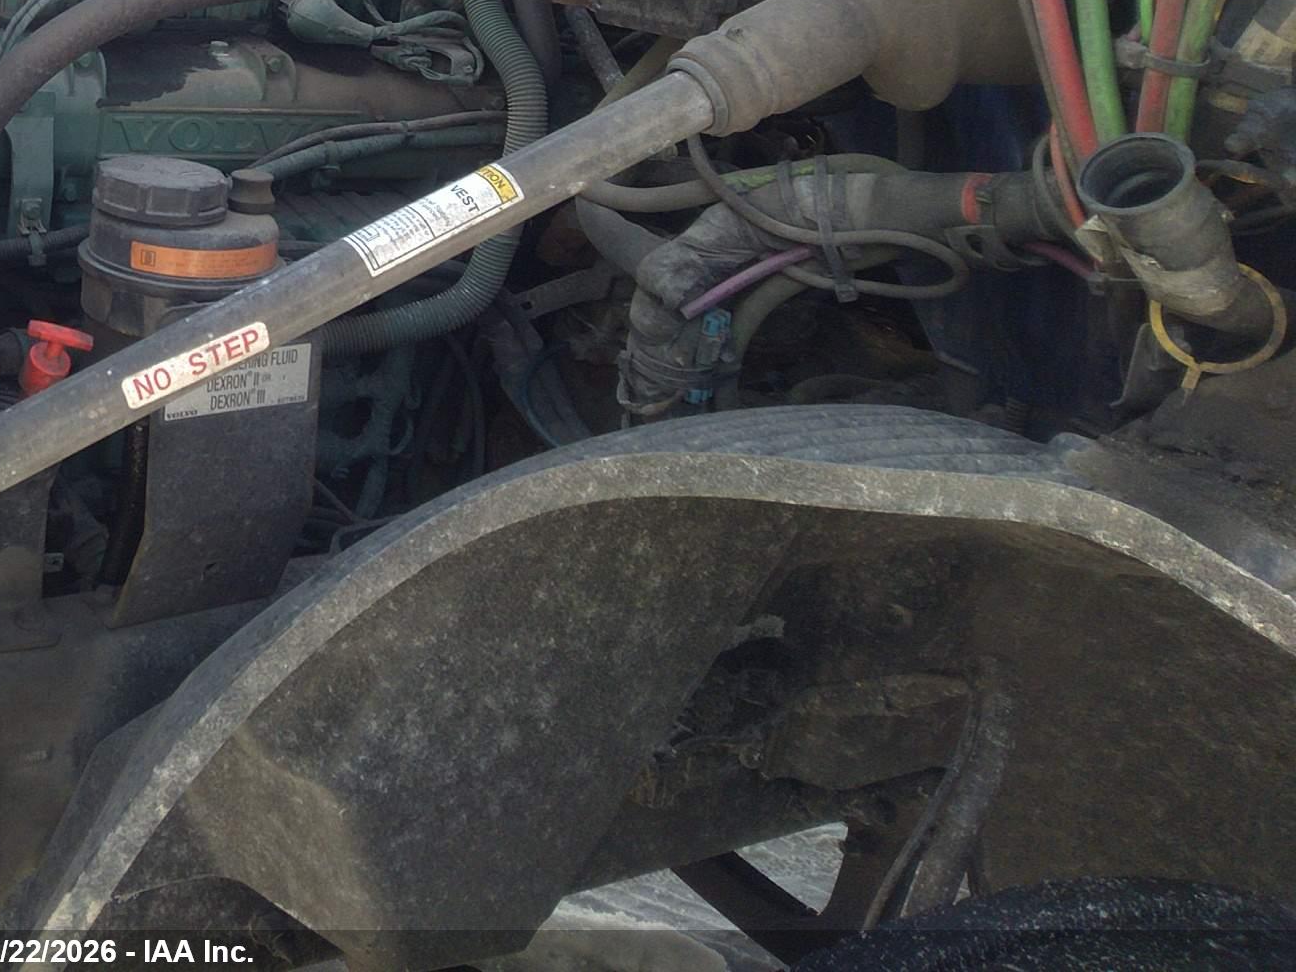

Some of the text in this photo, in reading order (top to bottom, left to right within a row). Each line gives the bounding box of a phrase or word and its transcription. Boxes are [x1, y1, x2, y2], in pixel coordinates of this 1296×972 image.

[450, 184, 480, 214] VEST
[133, 328, 259, 401] NO STEP
[270, 348, 299, 367] FLUID
